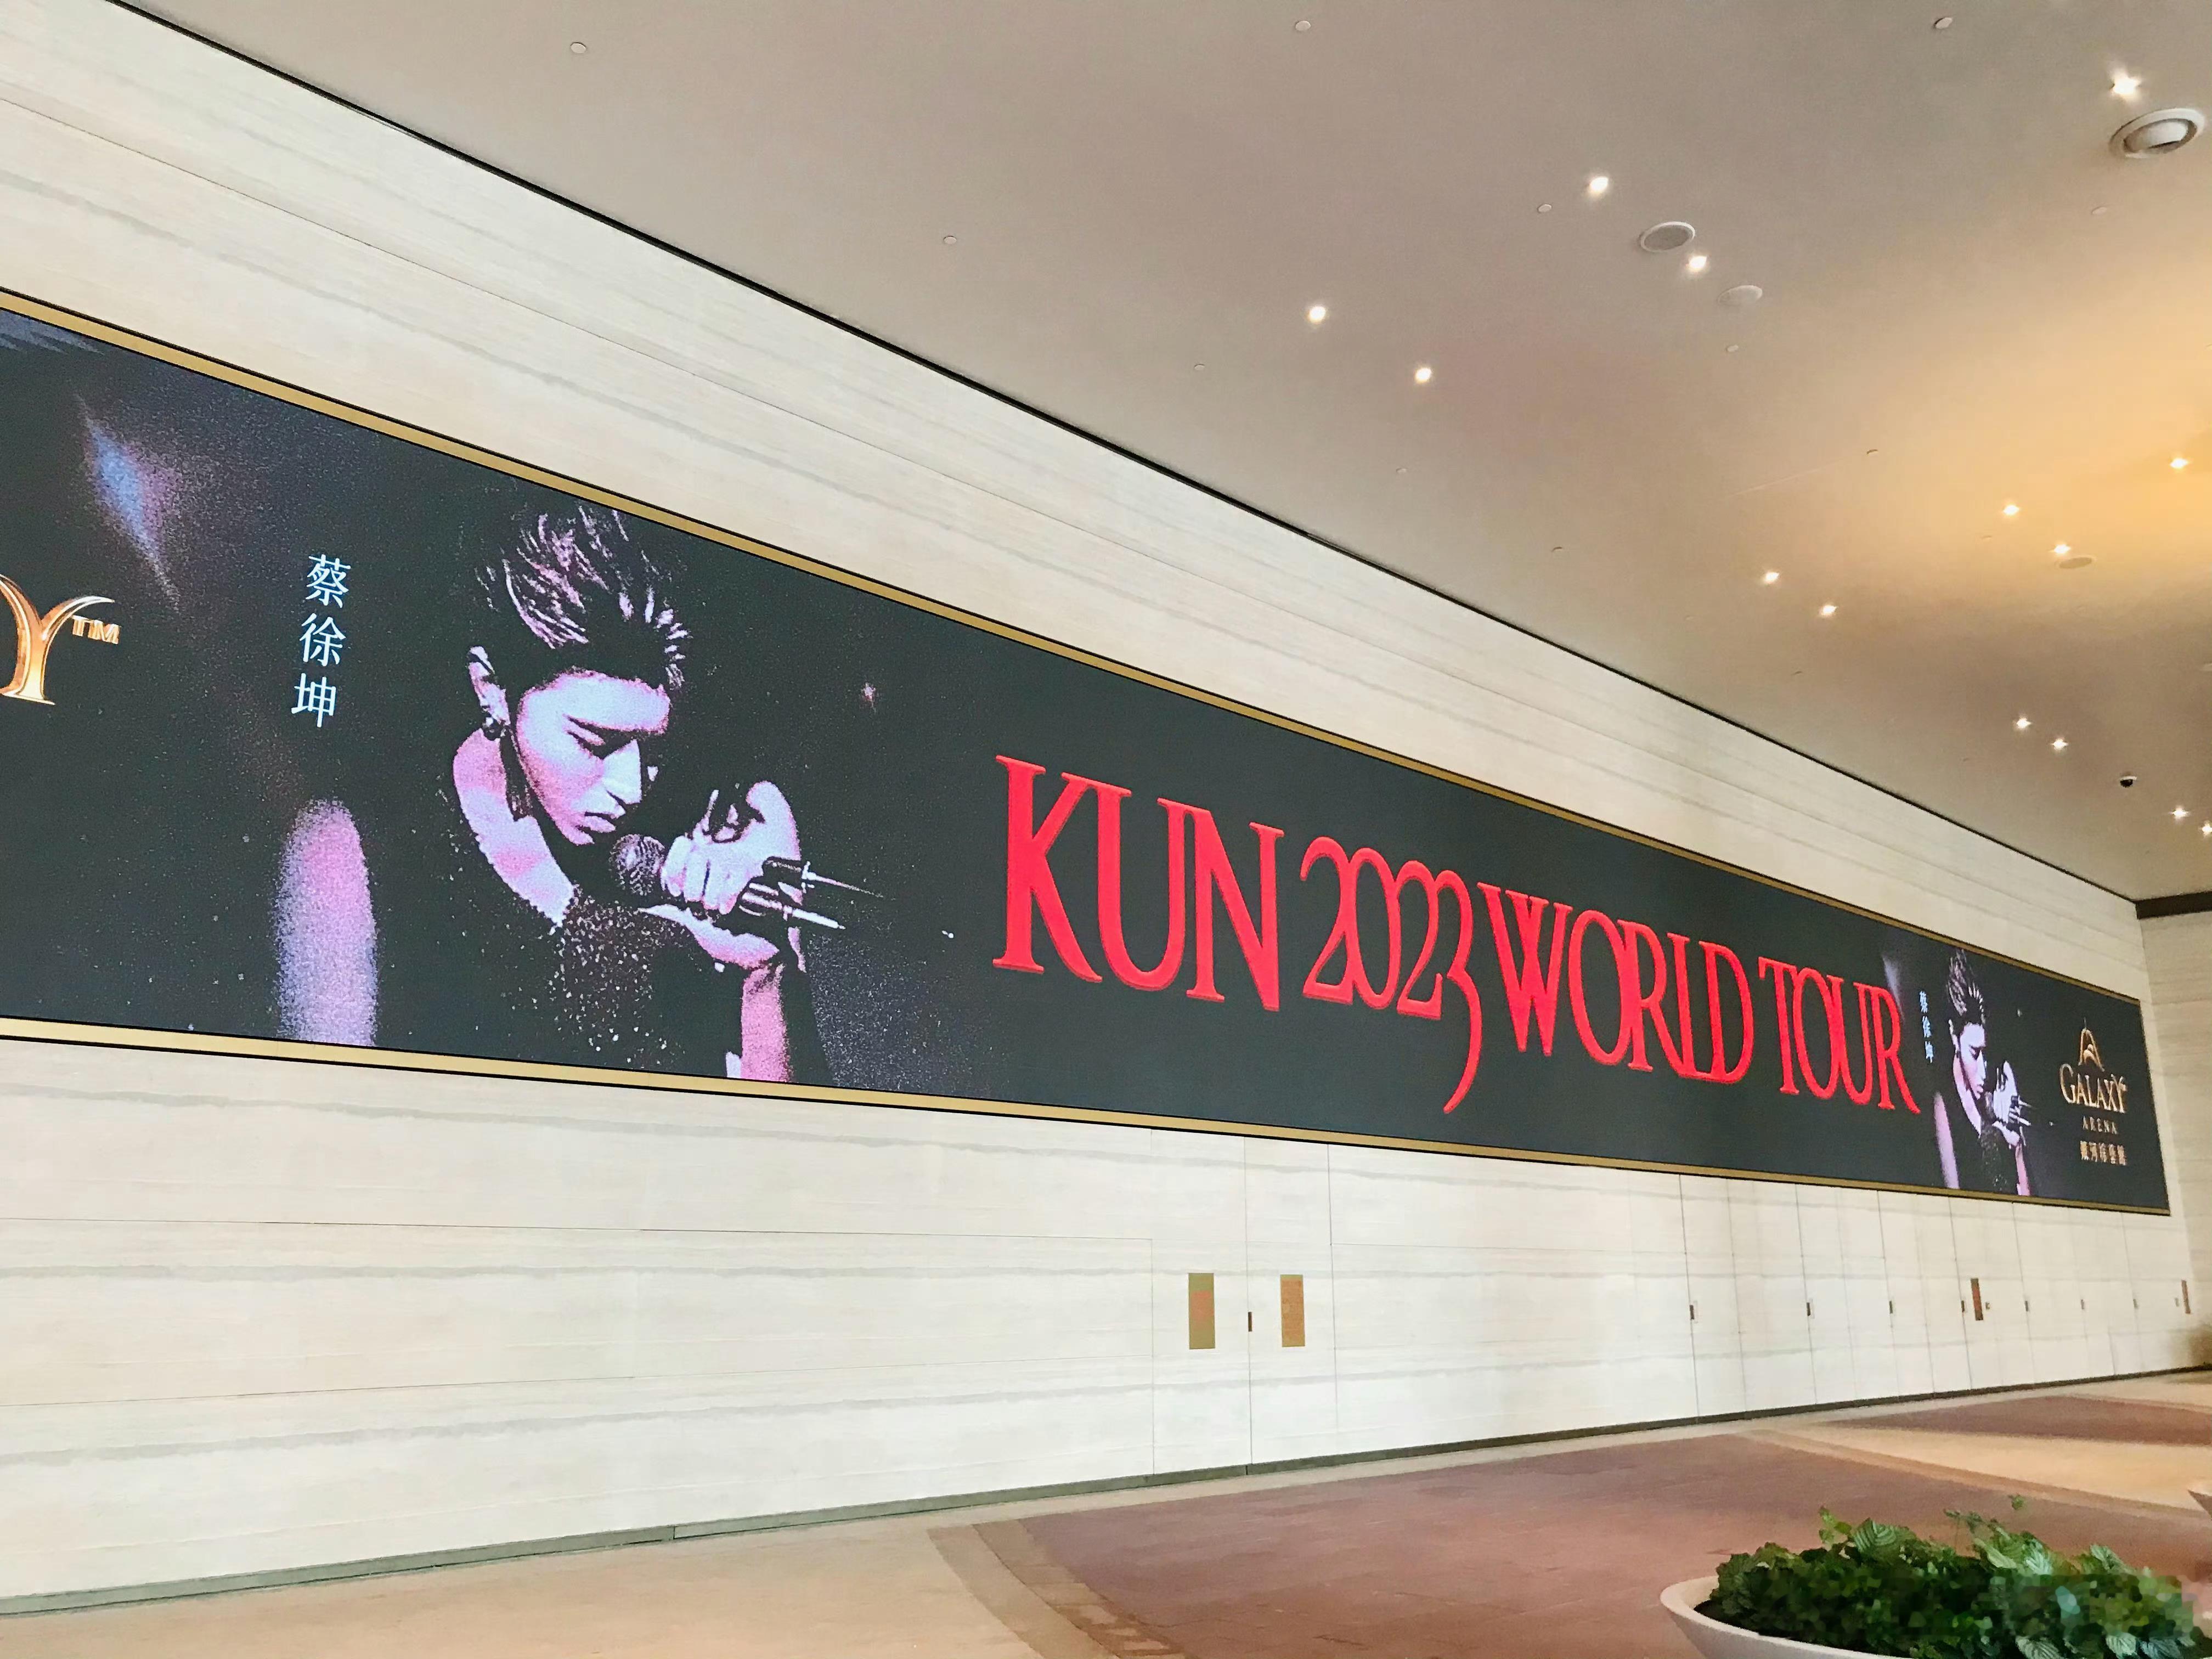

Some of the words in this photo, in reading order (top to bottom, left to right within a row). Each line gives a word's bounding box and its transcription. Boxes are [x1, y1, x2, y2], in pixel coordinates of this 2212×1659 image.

[291, 554, 351, 728] 蔡徐坤
[993, 755, 1284, 1012] KUN
[1300, 836, 1483, 1114] 2023
[1477, 882, 1754, 1084] WORLD
[1758, 956, 1921, 1114] TOUR
[2060, 1063, 2127, 1114] GALAXY
